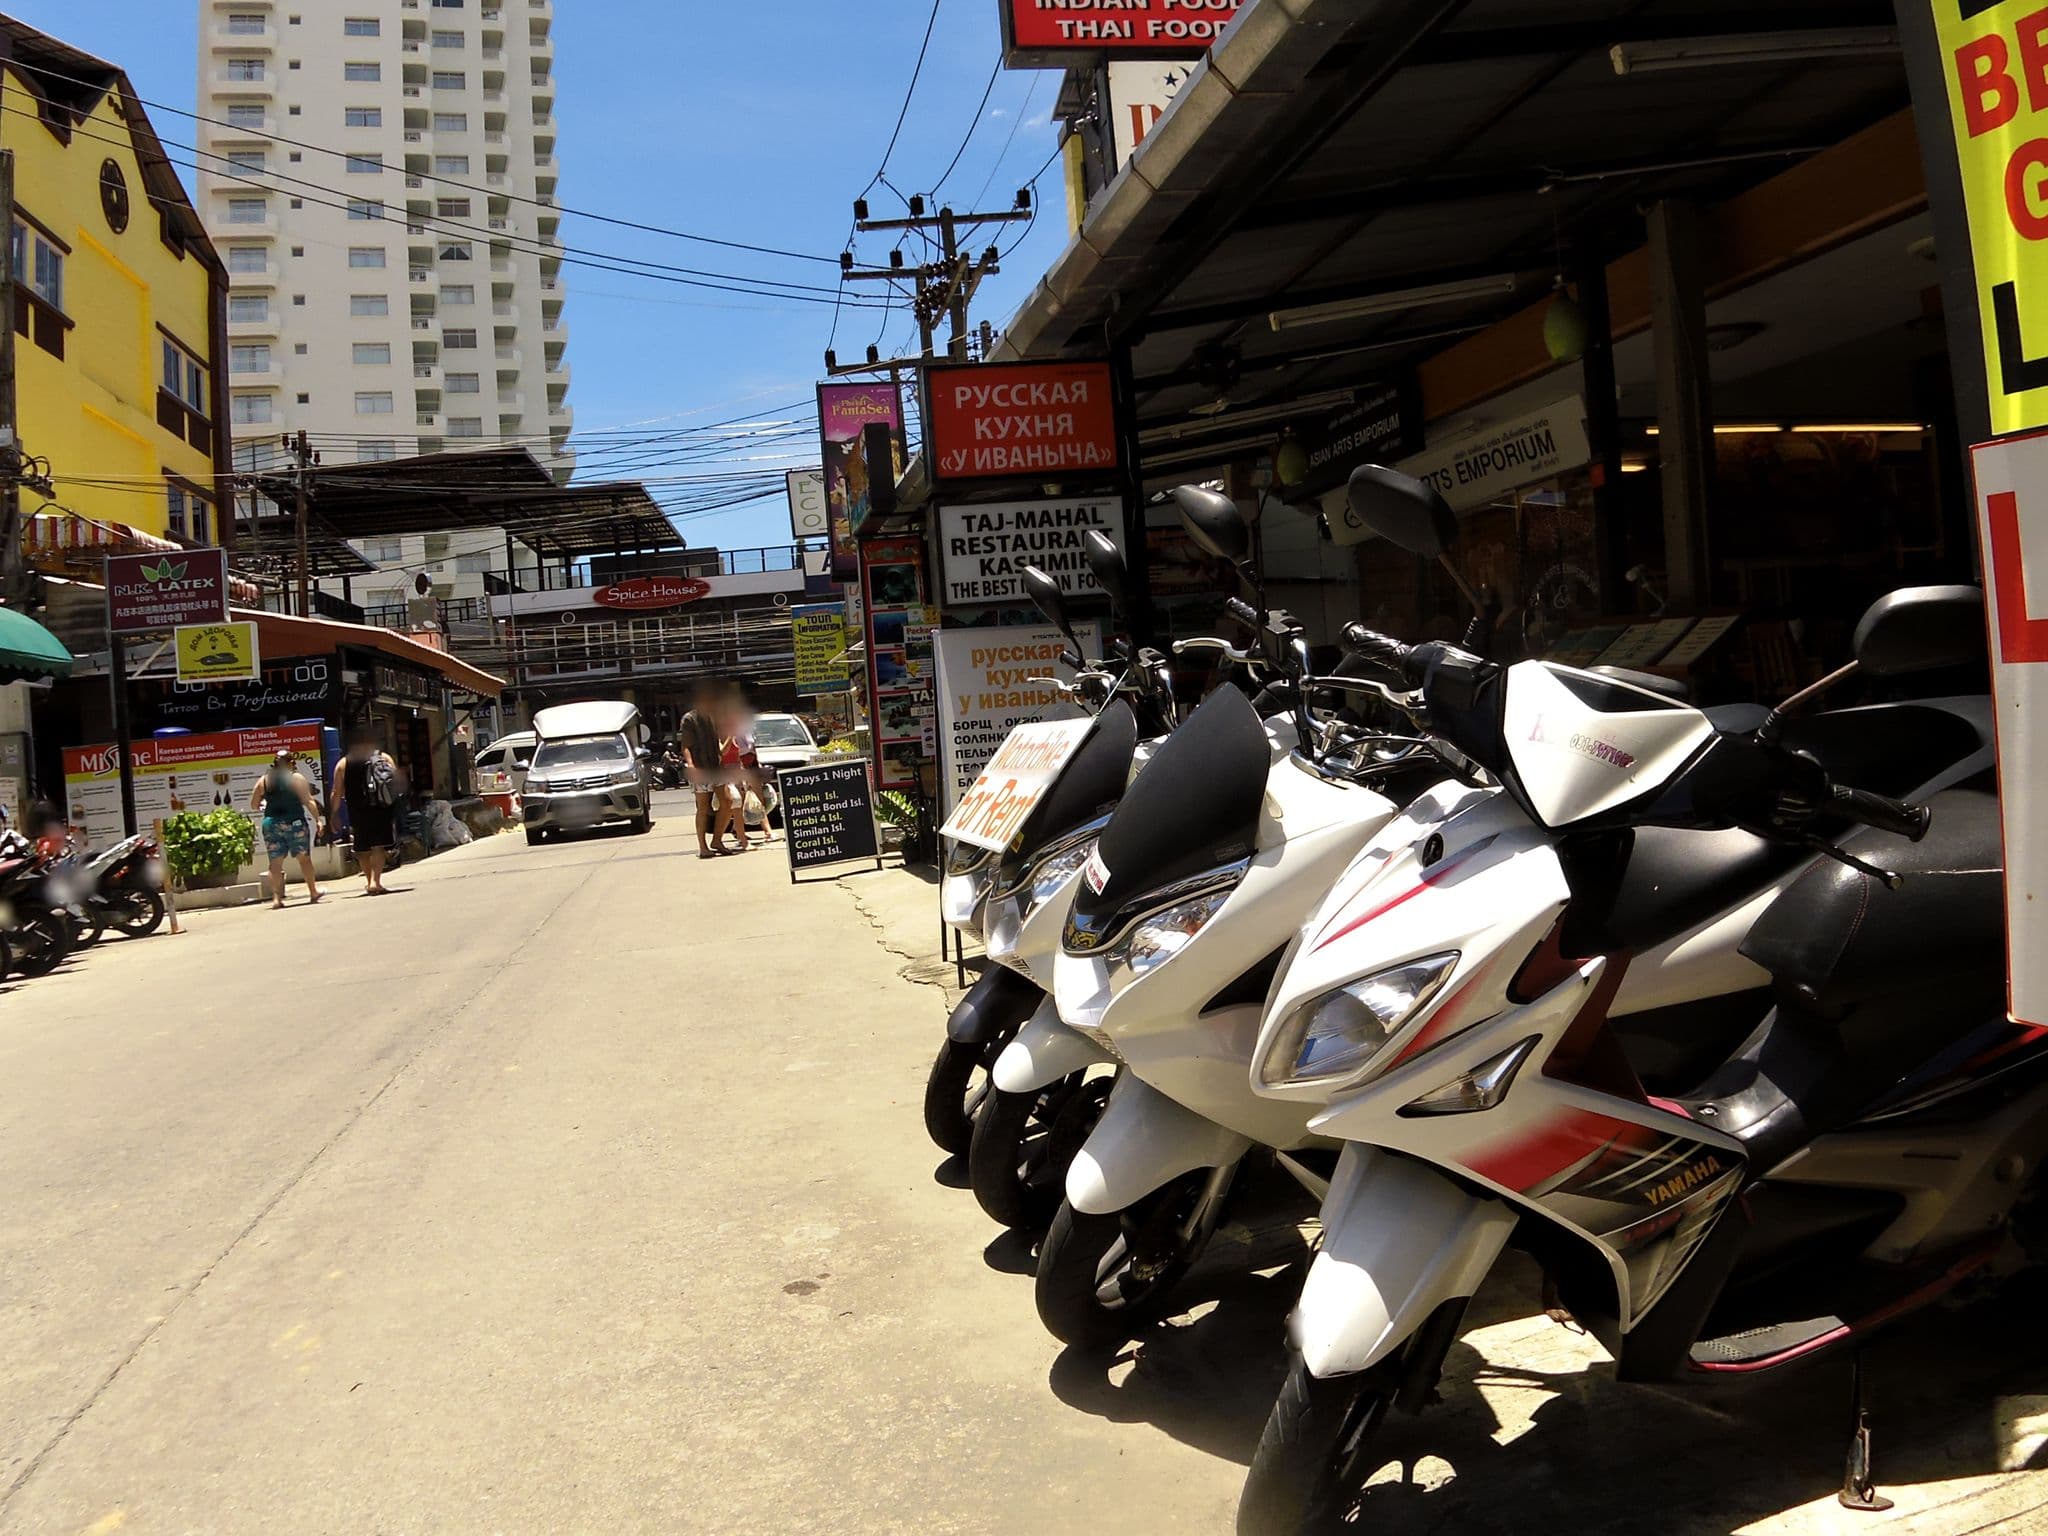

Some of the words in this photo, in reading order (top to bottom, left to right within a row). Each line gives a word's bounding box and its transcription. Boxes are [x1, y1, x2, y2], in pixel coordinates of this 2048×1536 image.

[1055, 20, 1132, 38] THAI
[954, 380, 1088, 409] РУССКАЯ
[832, 404, 891, 416] FantaSea
[974, 413, 1074, 441] КУХНЯ
[1309, 442, 1332, 469] ASIAN
[1332, 434, 1353, 458] ARTS
[1354, 412, 1400, 447] EMPORIUM
[1420, 470, 1453, 493] RTS
[1455, 429, 1556, 485] EMPORIUM
[961, 507, 1104, 533] TAJ-MAHAL
[114, 583, 153, 596] N.K.
[158, 578, 215, 592] LATEX
[607, 587, 649, 603] Spice
[652, 584, 699, 598] House
[951, 581, 979, 599] THE
[982, 578, 1017, 597] BEST
[804, 614, 832, 624] TOUR
[232, 682, 329, 711] Professional
[158, 746, 183, 755] Korean
[184, 743, 215, 752] cosmetic
[786, 777, 792, 786] 2
[795, 774, 820, 785] Days
[823, 772, 830, 780] 1
[832, 768, 862, 780] Night
[789, 793, 820, 805] PhiPhi
[824, 790, 839, 800] Isl.
[790, 806, 821, 817] James
[822, 800, 848, 811] Bond
[850, 798, 864, 807] Isl.
[947, 776, 995, 831] For
[971, 779, 1045, 843] Rent
[792, 815, 818, 827] Krabi
[820, 814, 827, 822] 4
[829, 812, 843, 821] Isl.
[793, 826, 829, 839] Similan
[831, 823, 846, 832] Isl.
[795, 838, 821, 849] Coral
[822, 835, 837, 845] Isl.
[796, 848, 826, 860] Racha
[828, 845, 842, 855] Isl.
[1644, 1154, 1721, 1206] YAMAHA
